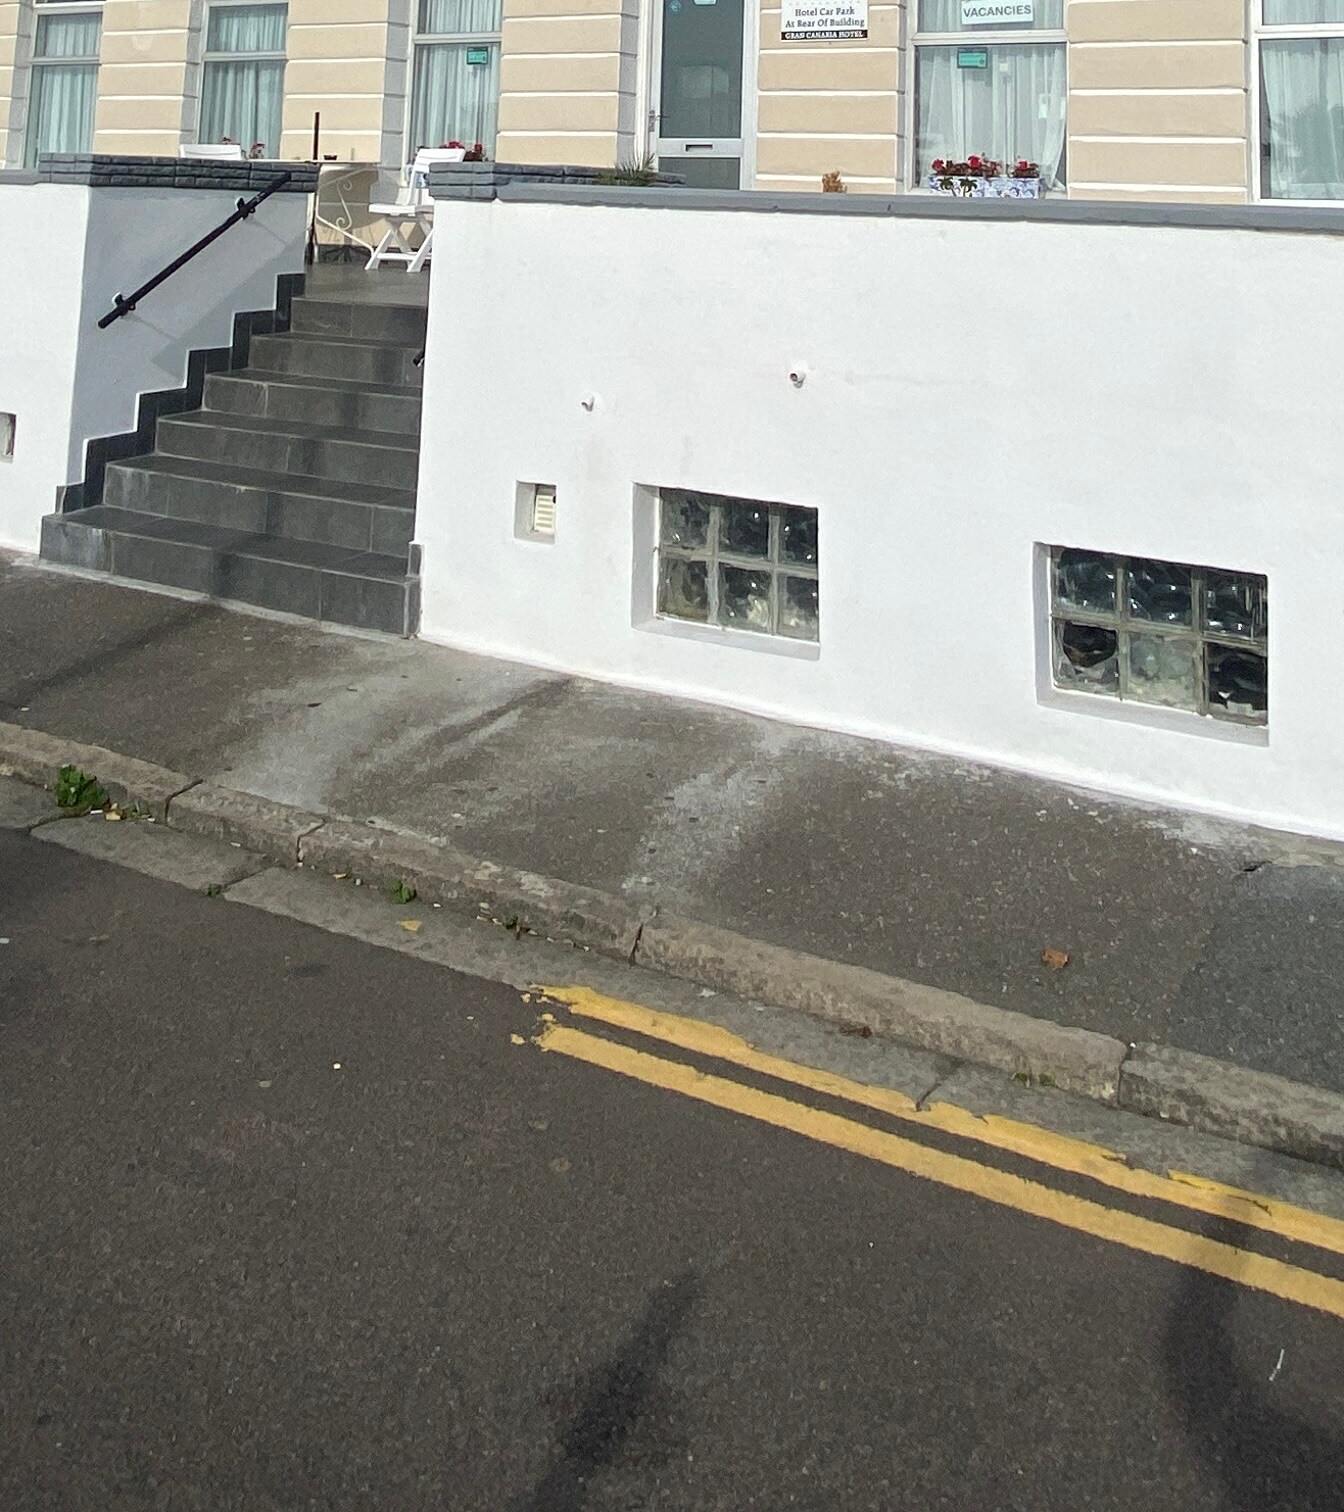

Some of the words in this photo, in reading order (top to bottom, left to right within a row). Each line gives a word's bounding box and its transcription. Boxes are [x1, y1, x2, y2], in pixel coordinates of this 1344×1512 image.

[795, 8, 817, 16] Hotel
[819, 8, 834, 16] Car
[836, 6, 855, 15] Park
[963, 5, 1031, 17] VACANCIES
[785, 20, 795, 28] At
[797, 20, 815, 28] Rear
[817, 18, 828, 27] Of
[830, 18, 865, 28] Building
